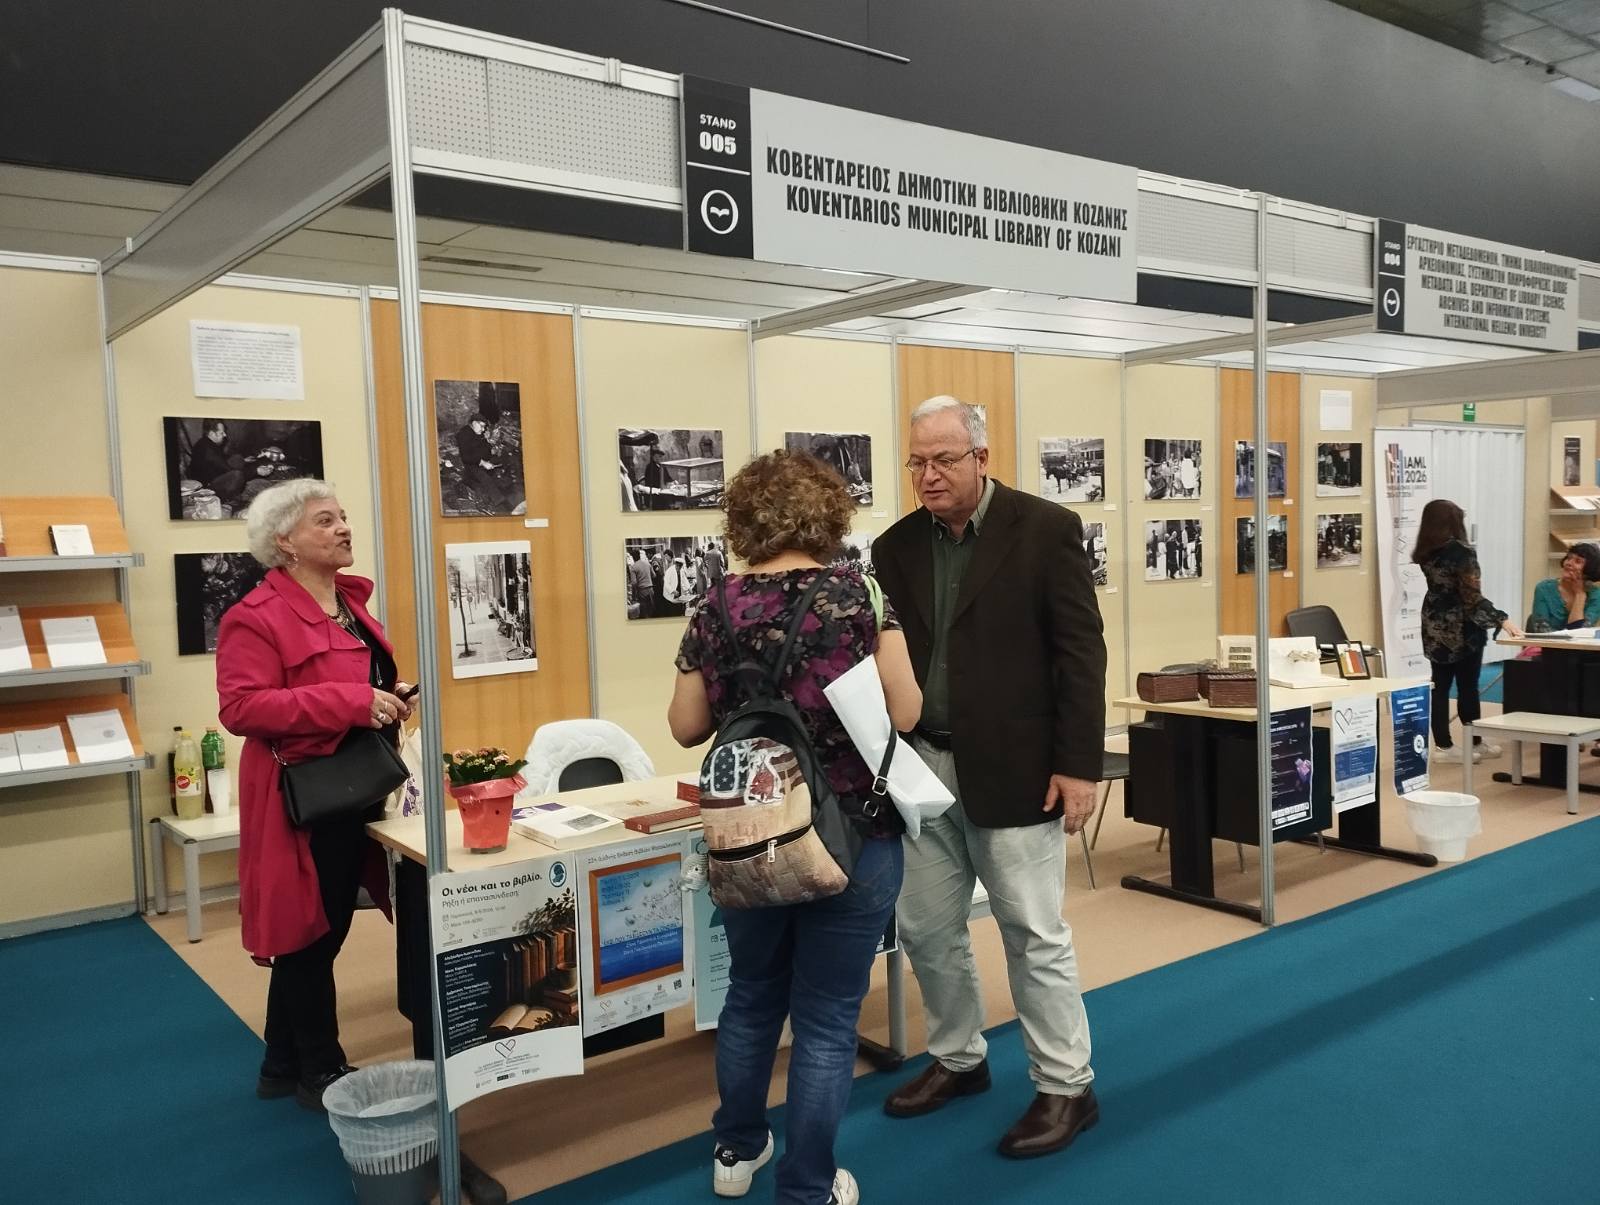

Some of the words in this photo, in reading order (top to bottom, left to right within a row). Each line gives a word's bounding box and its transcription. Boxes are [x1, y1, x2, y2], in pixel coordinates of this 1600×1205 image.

[699, 113, 737, 131] STAND
[699, 131, 737, 156] 005
[766, 146, 891, 194] ΚΟΒΕΝΤΑΡΕΙΟΣ
[897, 171, 977, 208] ΔΗΜΟΤΙΚΗ
[983, 186, 1068, 222] ΒΙΒΛΙΟΘΗΚΗ
[1073, 200, 1128, 232] ΚΟΖΑΝΗΣ
[786, 184, 901, 228] KOVENTARIOS
[908, 204, 989, 241] MUNICIPAL
[994, 220, 1051, 250] LIBRARY
[1056, 231, 1072, 252] OF
[1077, 231, 1122, 258] KOZANI
[1403, 456, 1427, 469] IAML
[1404, 470, 1427, 483] 2026
[441, 887, 453, 897] Οι
[456, 884, 477, 894] νέοι
[480, 882, 497, 890] και
[499, 880, 511, 888] το
